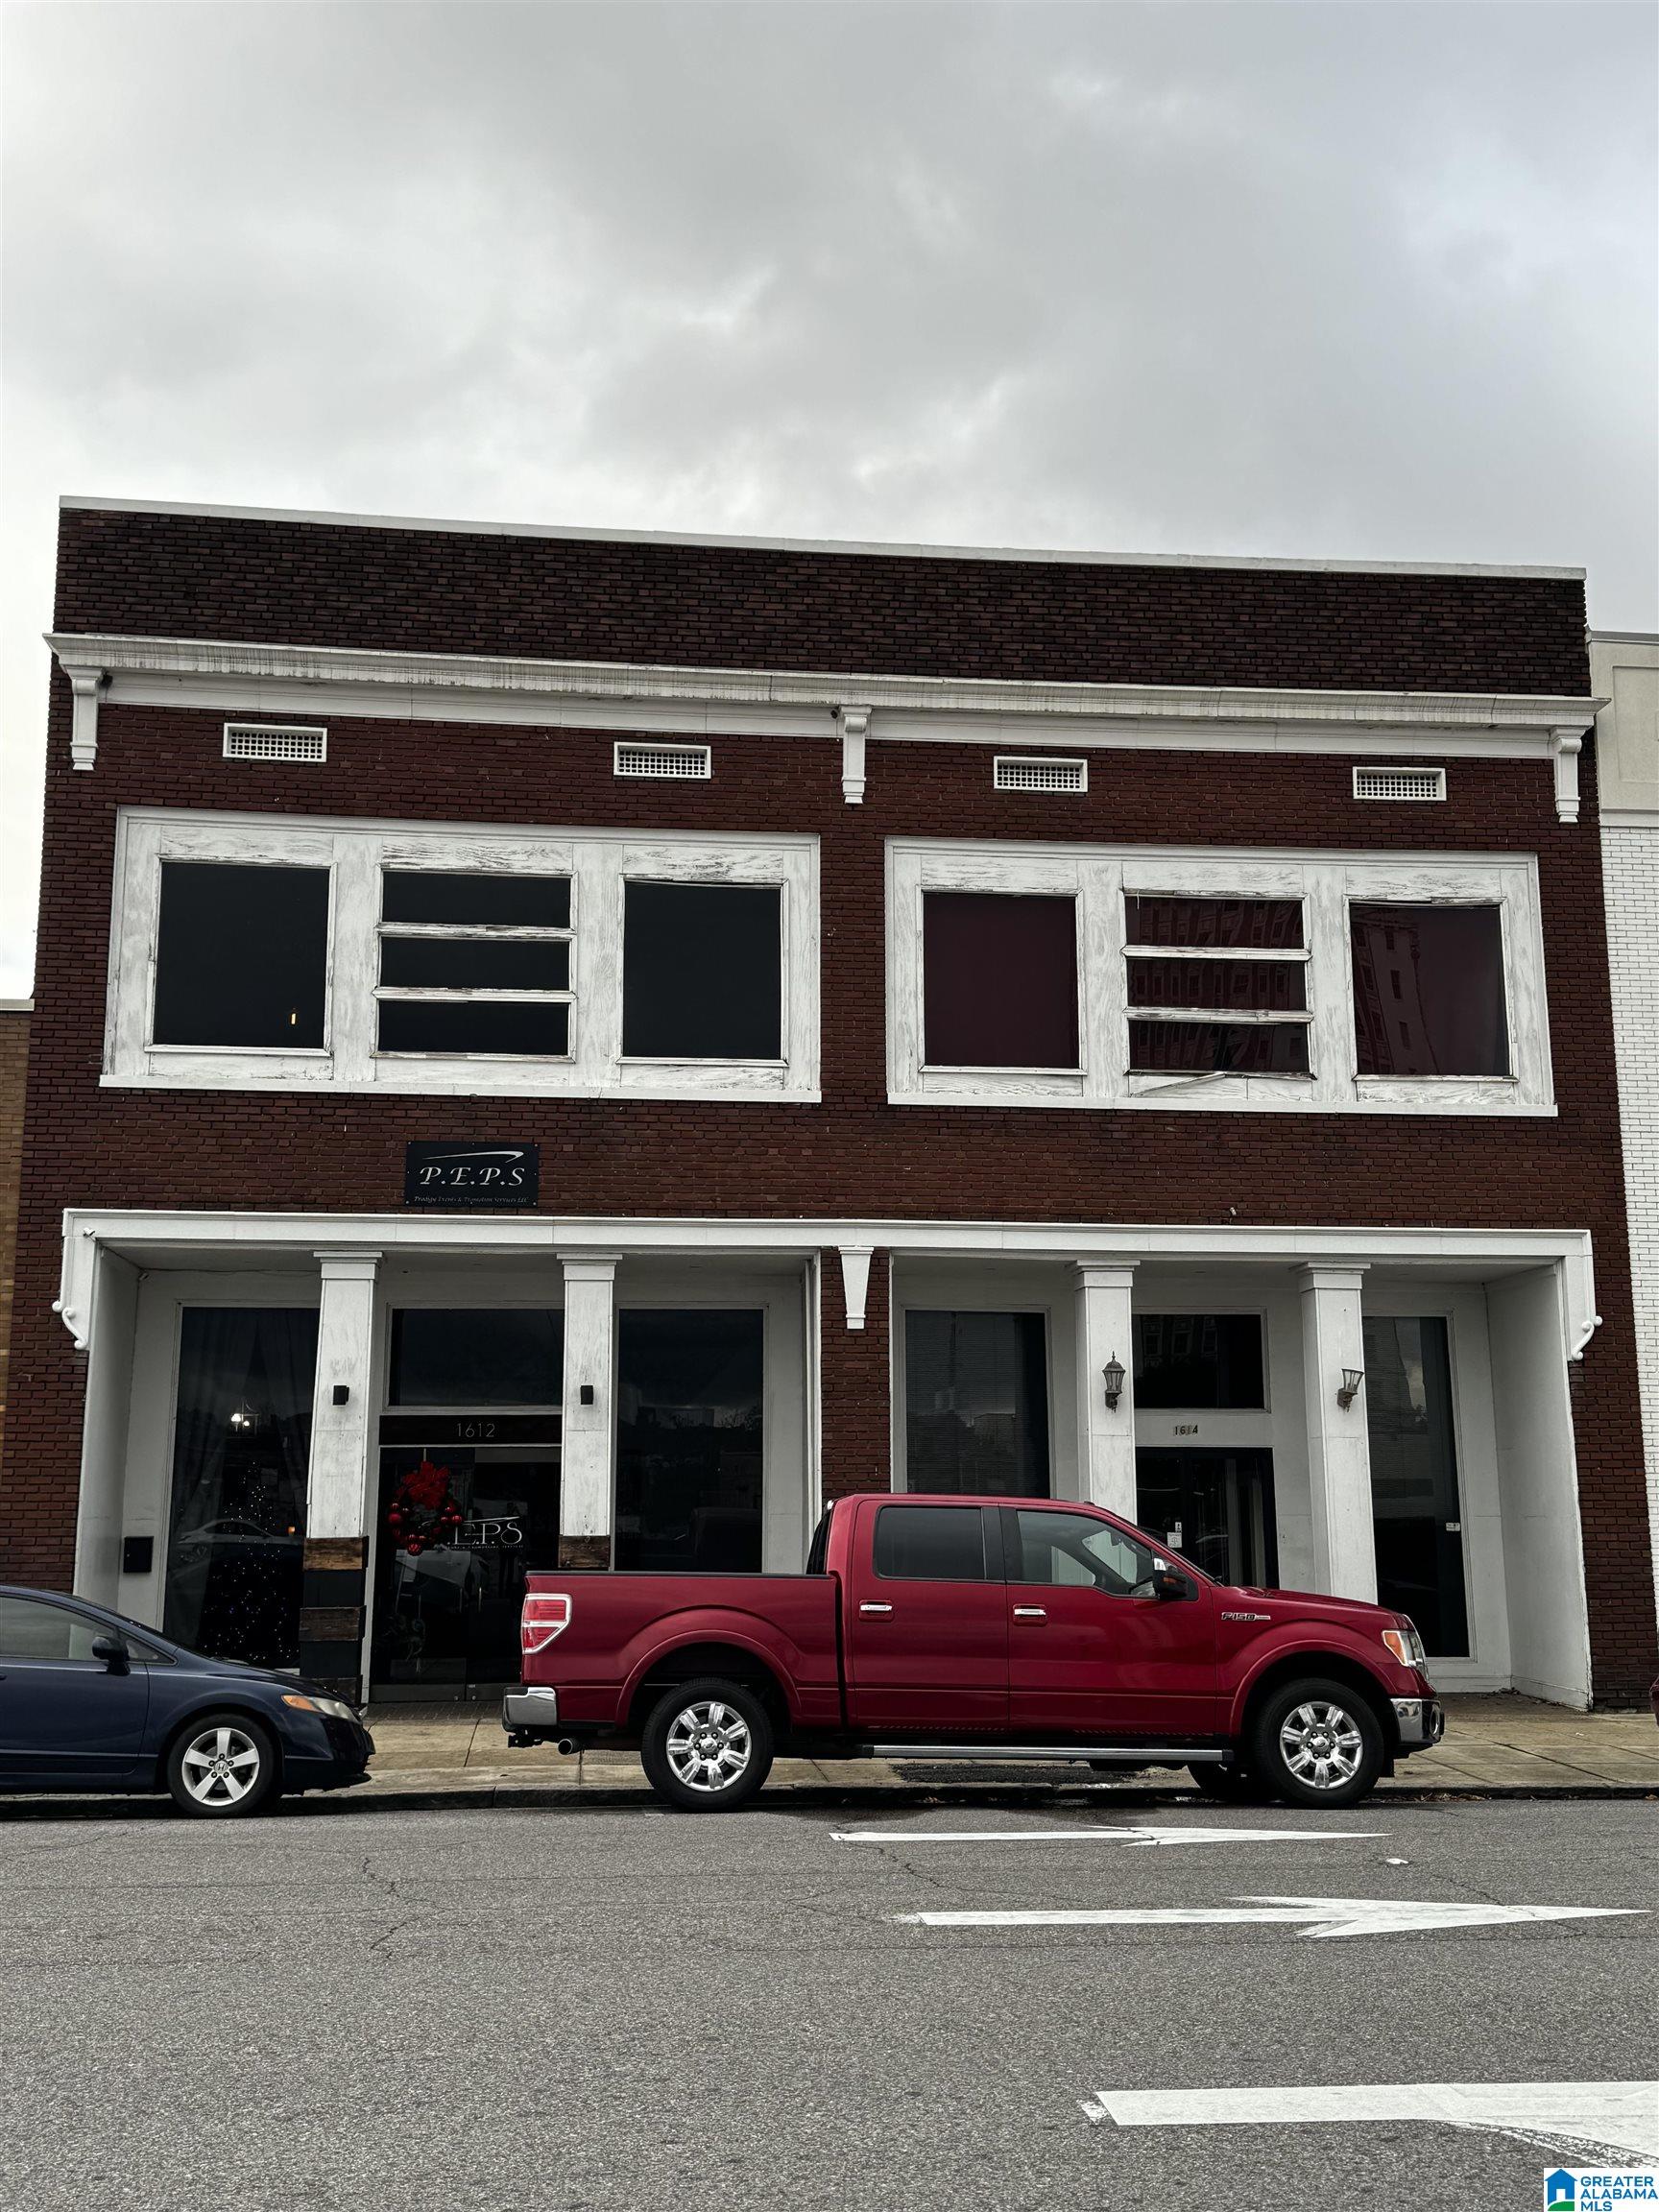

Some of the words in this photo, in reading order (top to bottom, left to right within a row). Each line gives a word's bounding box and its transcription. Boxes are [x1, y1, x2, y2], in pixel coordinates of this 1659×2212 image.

[420, 1166, 525, 1186] P.E.P.S
[456, 1423, 495, 1438] 1612
[1175, 1425, 1198, 1435] 1614
